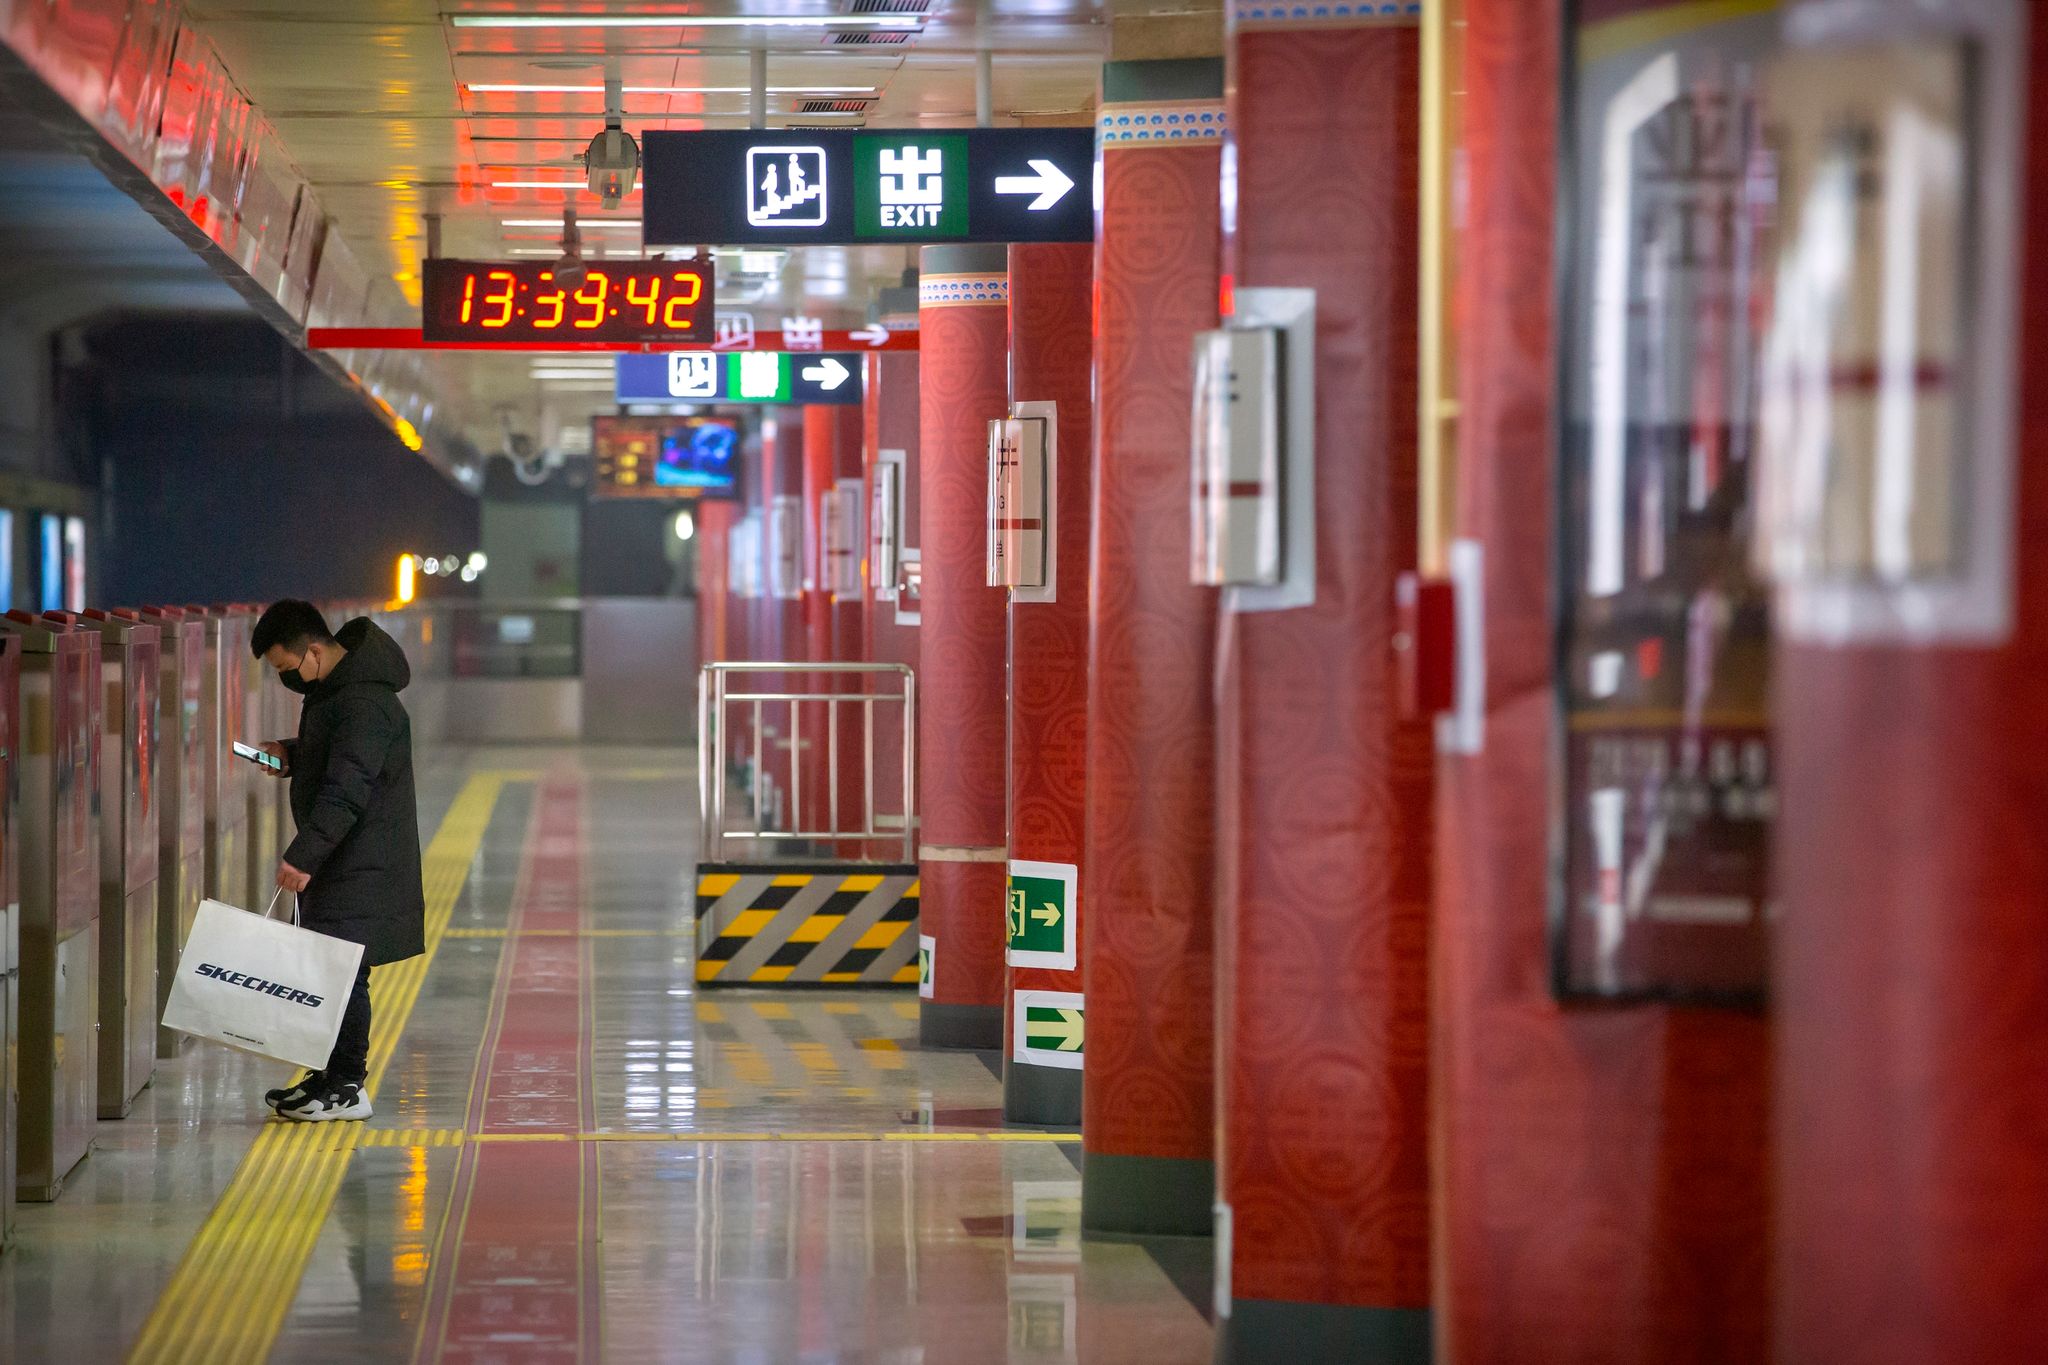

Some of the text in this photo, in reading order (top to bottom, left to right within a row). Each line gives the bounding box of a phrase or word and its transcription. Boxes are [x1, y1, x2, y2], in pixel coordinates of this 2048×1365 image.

[879, 146, 942, 205] 出
[880, 205, 943, 227] EXIT
[459, 271, 703, 329] 13:39:42
[195, 963, 325, 1008] SKECHERS
